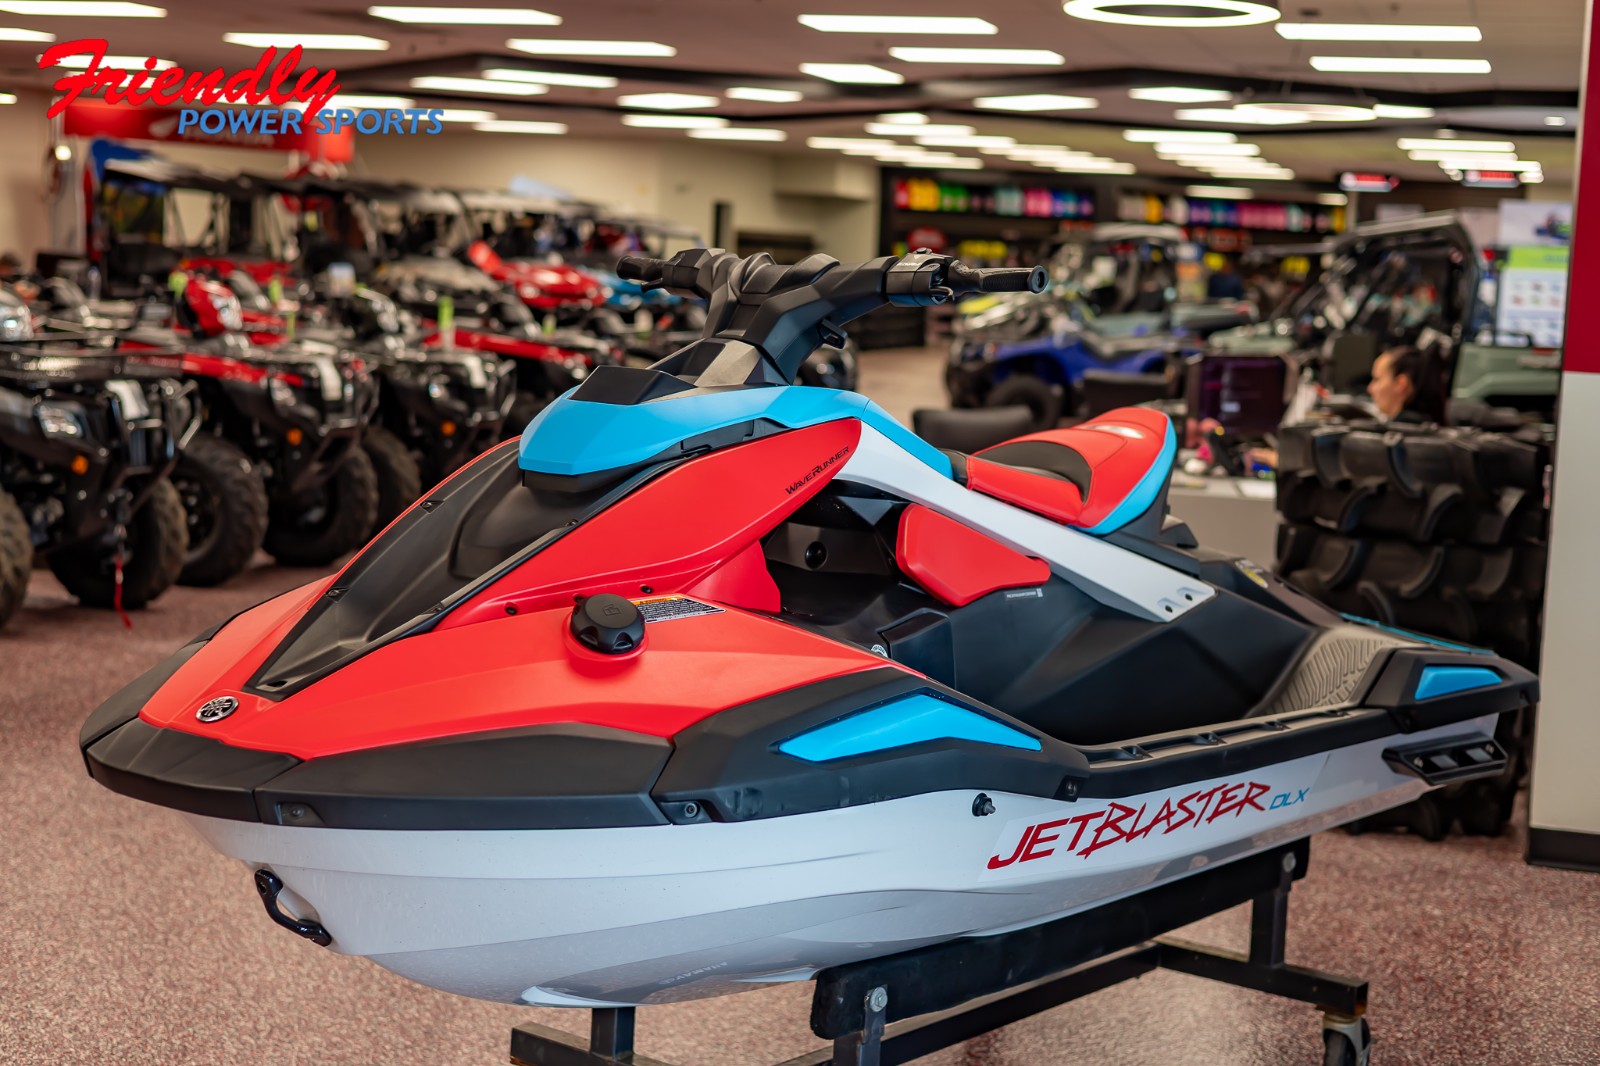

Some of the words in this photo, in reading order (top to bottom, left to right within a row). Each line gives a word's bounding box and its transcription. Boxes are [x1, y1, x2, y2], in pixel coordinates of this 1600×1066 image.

[784, 445, 850, 495] WAVERUNNER
[987, 781, 1271, 870] JETBLASTER
[1269, 787, 1311, 811] DLX
